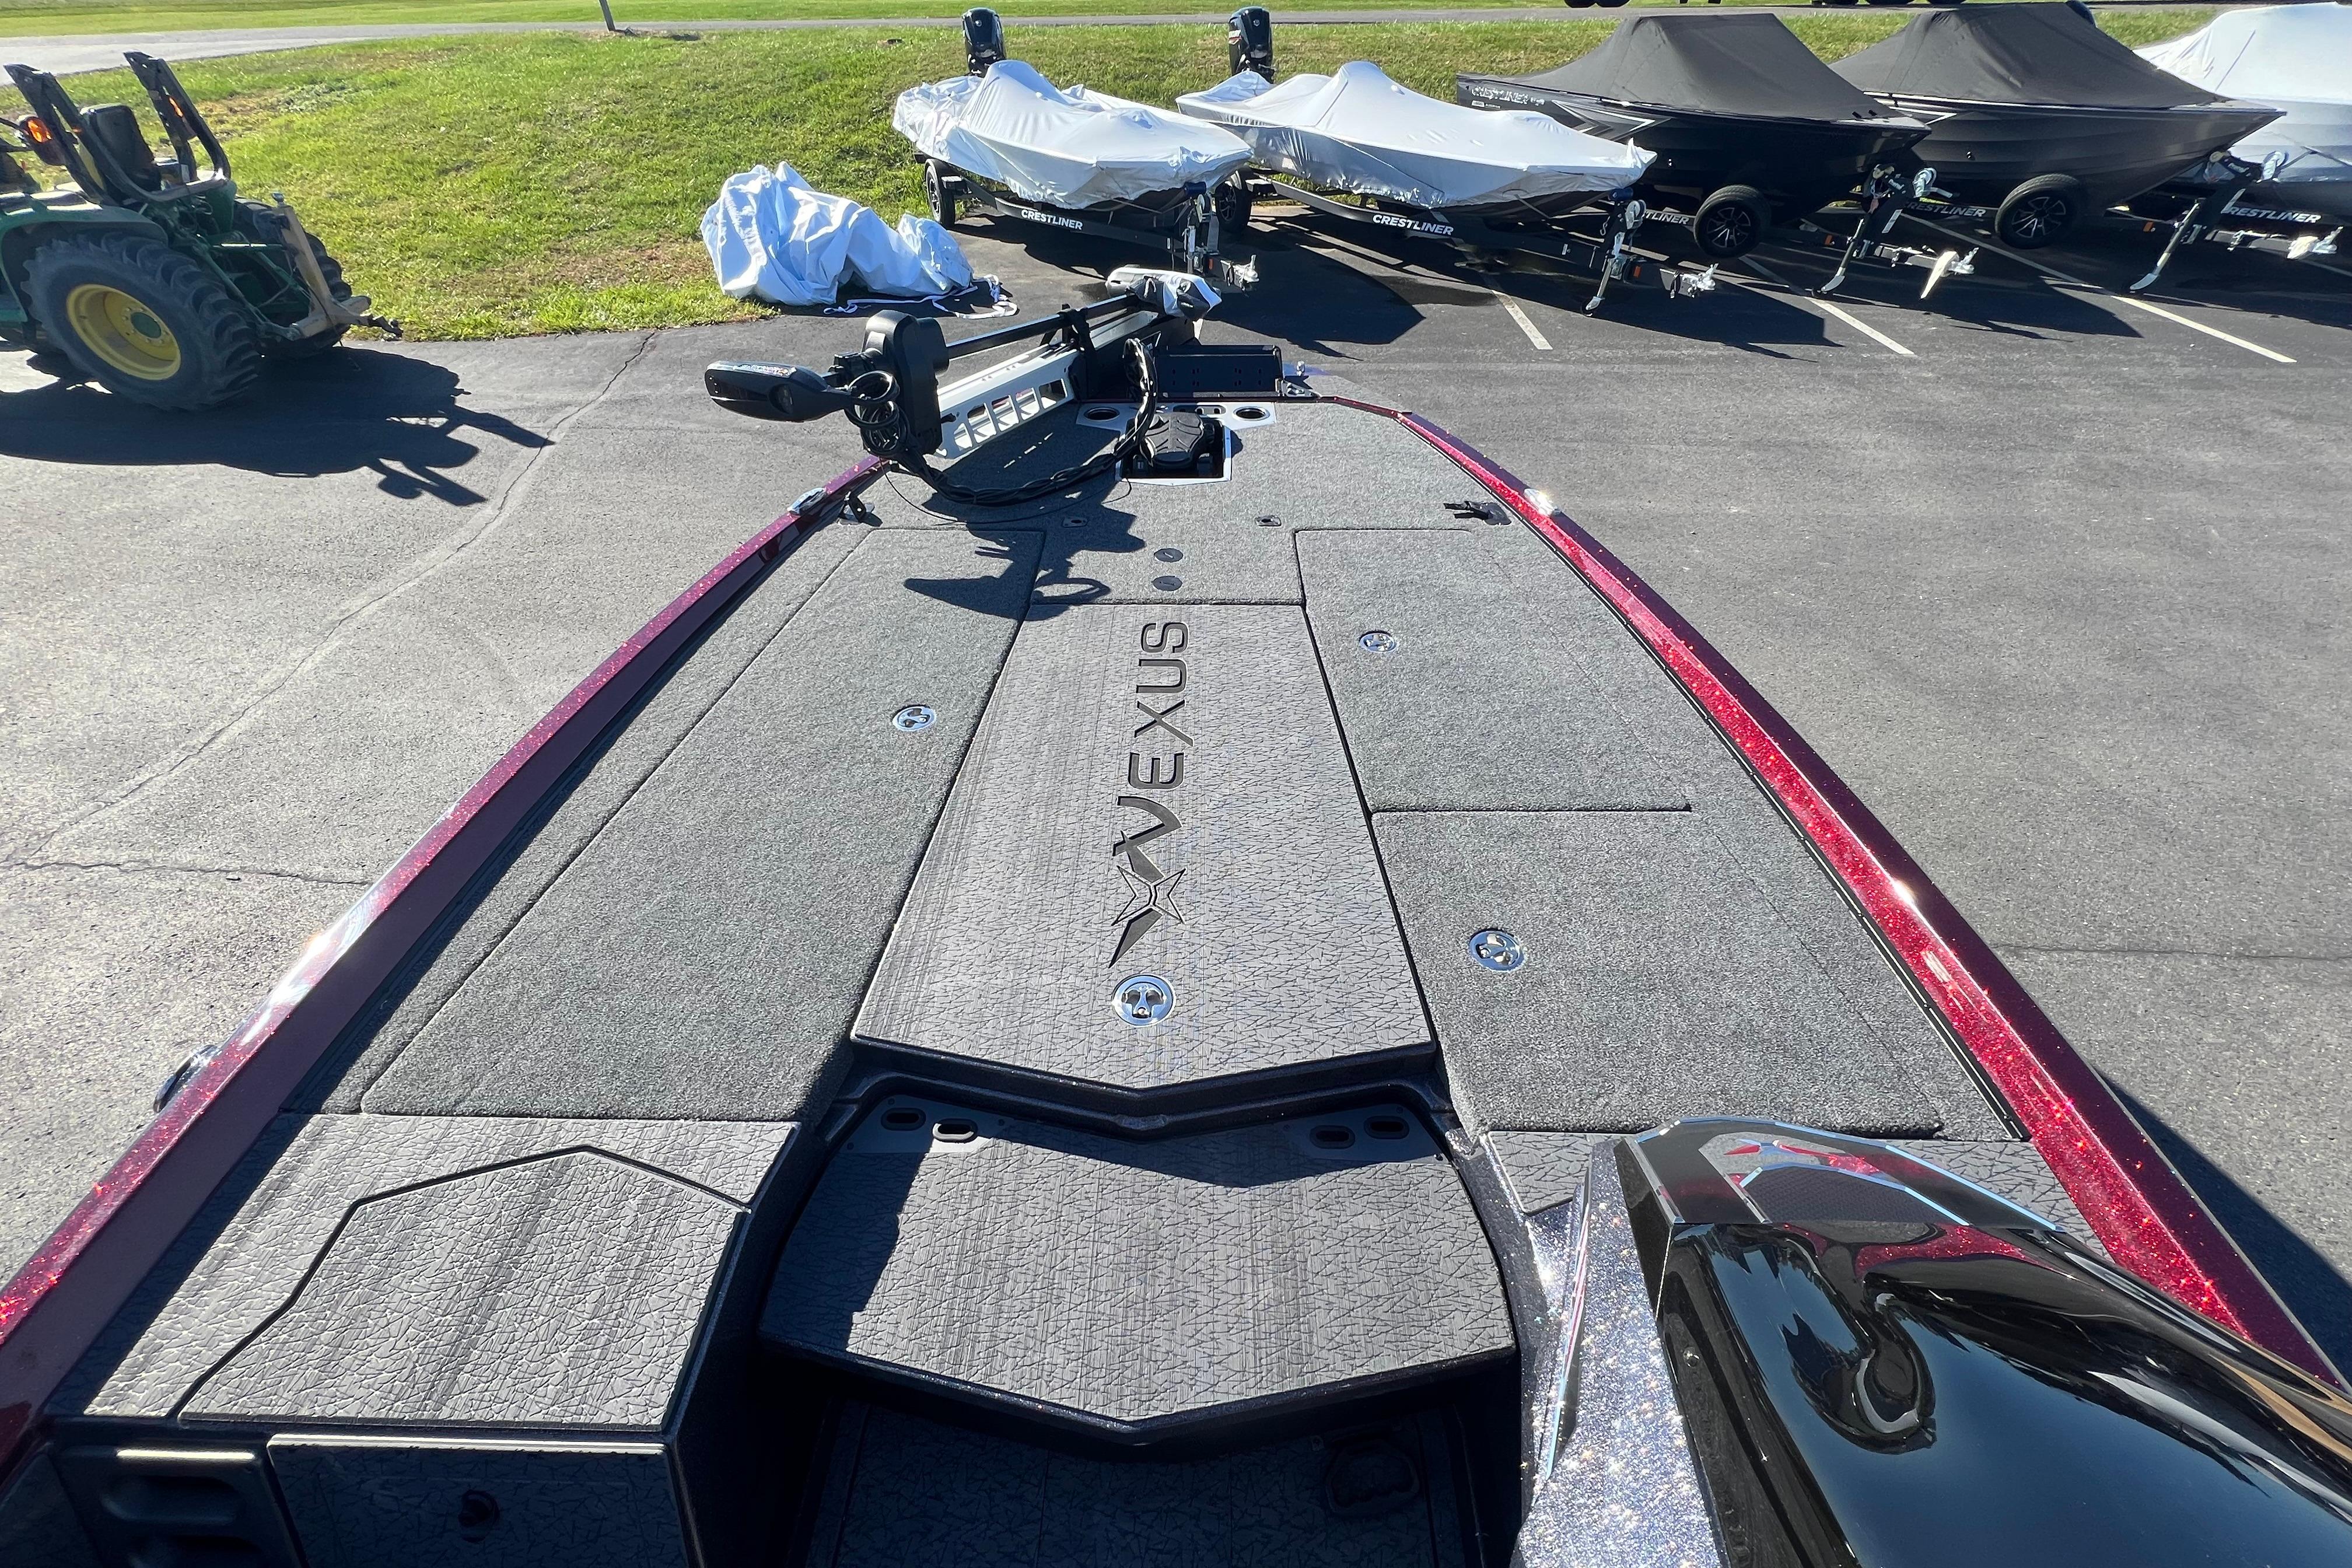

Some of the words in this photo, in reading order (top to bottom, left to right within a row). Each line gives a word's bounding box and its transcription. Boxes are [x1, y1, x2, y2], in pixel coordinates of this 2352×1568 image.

[1645, 210, 1690, 225] TLINER
[1904, 201, 1986, 218] RESTLINER
[2225, 206, 2322, 223] RESTLINER
[1021, 209, 1083, 230] CRESTLINER
[1373, 214, 1454, 236] CRESTLINER
[1112, 621, 1194, 857] VEXUS
